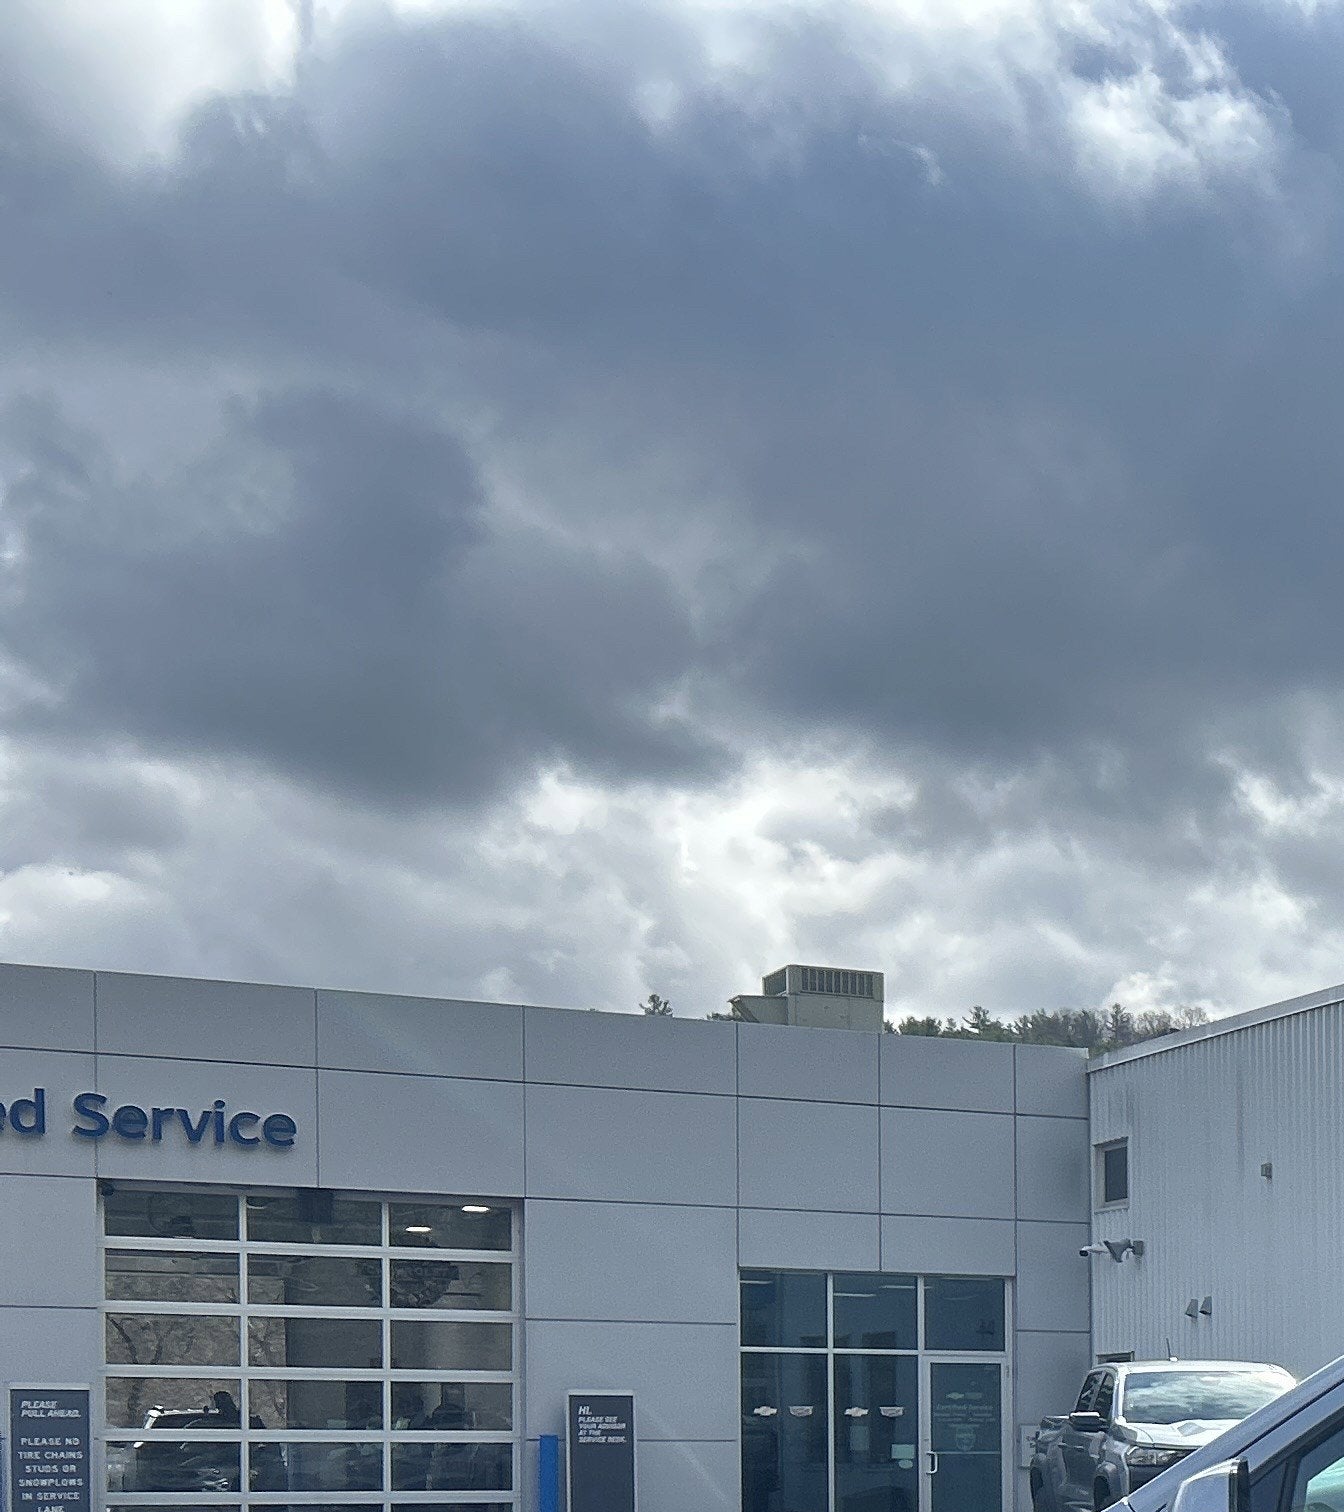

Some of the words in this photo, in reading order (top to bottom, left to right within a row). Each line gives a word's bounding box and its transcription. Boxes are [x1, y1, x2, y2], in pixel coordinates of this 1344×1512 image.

[0, 1088, 45, 1136] d
[72, 1092, 297, 1146] Service
[21, 1401, 57, 1409] PLEASE
[21, 1438, 61, 1446] PLEASE
[65, 1438, 80, 1446] NO
[18, 1452, 41, 1460] TIRE
[44, 1452, 83, 1460] CHAINS
[25, 1465, 59, 1473] STUDS
[62, 1465, 77, 1473] OR
[18, 1479, 83, 1487] SNOWPLOWS
[37, 1492, 80, 1501] SERVICE
